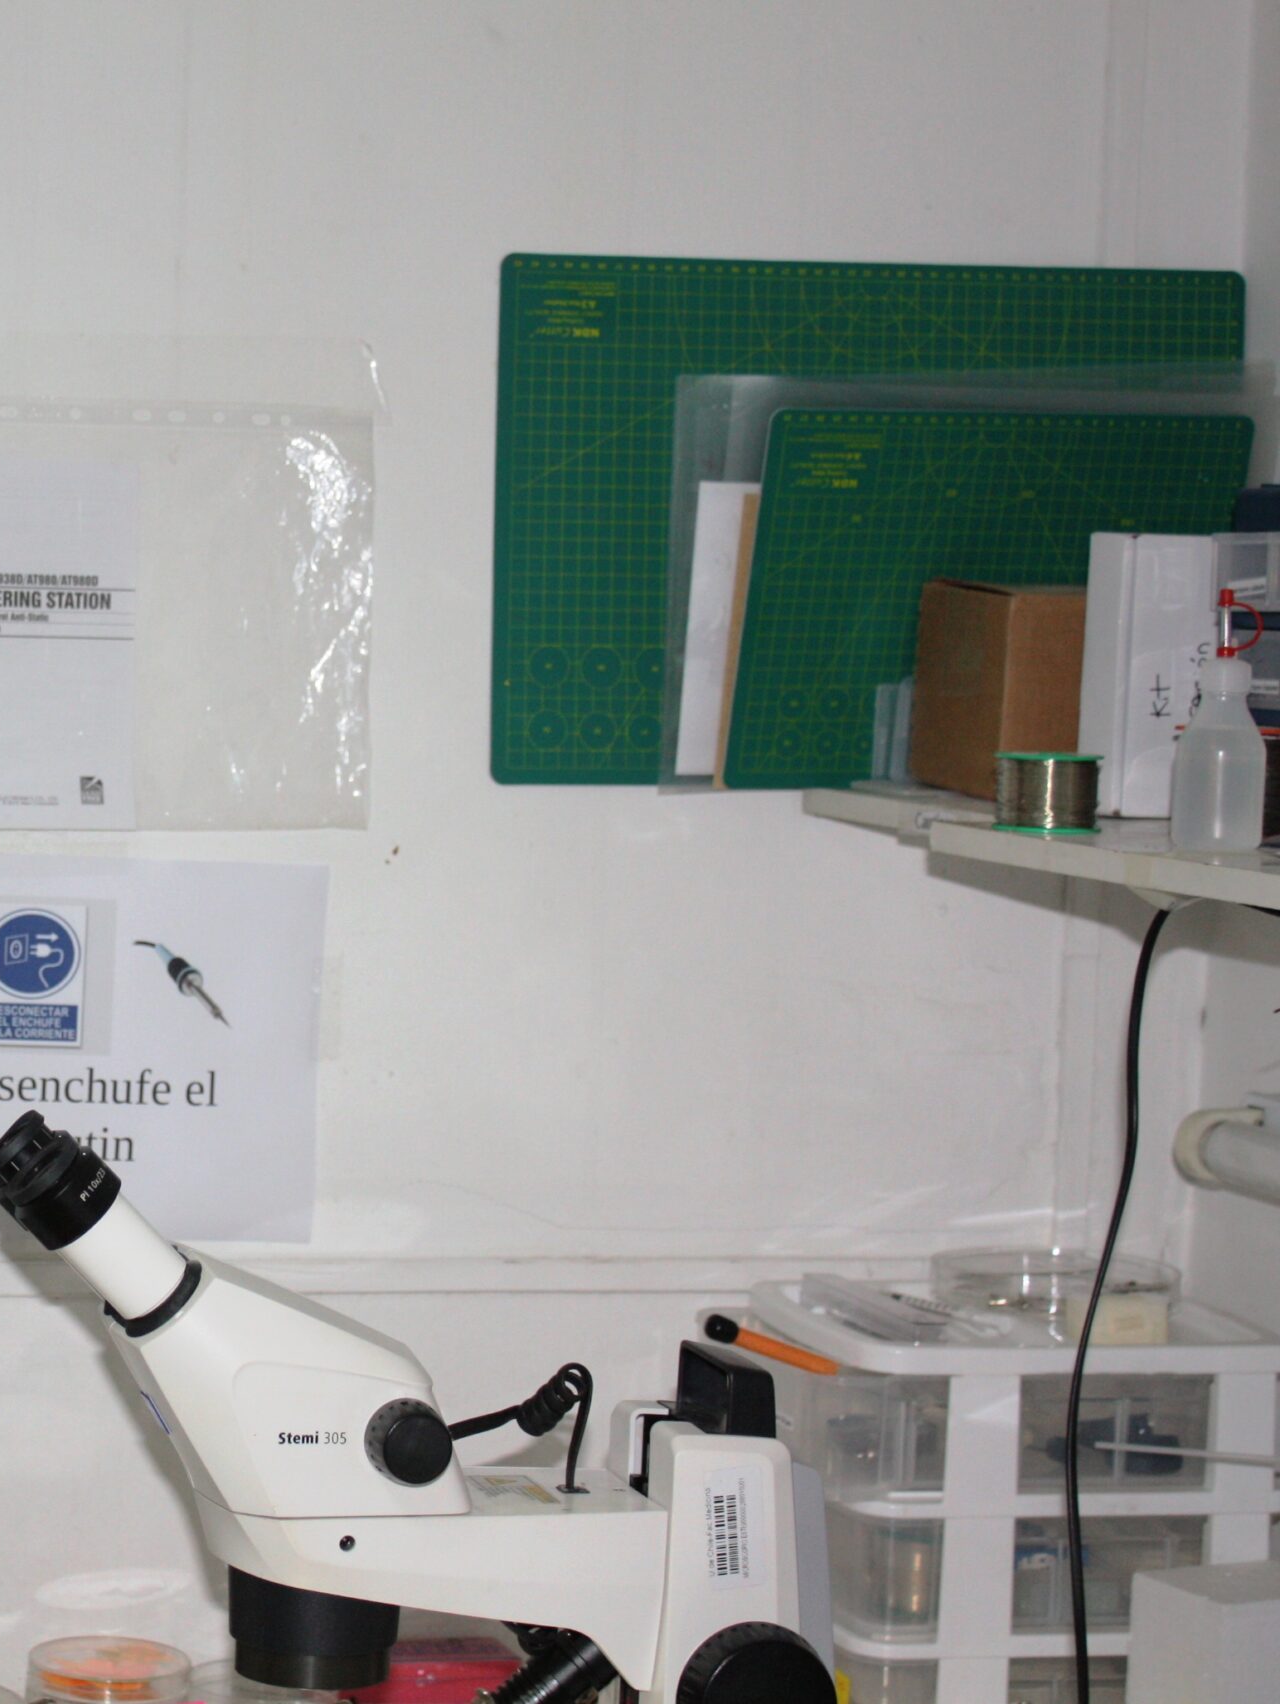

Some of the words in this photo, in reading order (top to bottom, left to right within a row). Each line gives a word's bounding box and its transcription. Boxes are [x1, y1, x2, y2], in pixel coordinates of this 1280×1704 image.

[46, 592, 112, 610] STATION
[11, 1017, 62, 1028] ENCHUFE
[14, 1028, 76, 1040] CORRIENTE
[185, 1070, 218, 1107] el
[278, 1431, 319, 1445] Stemi
[323, 1431, 347, 1445] 305
